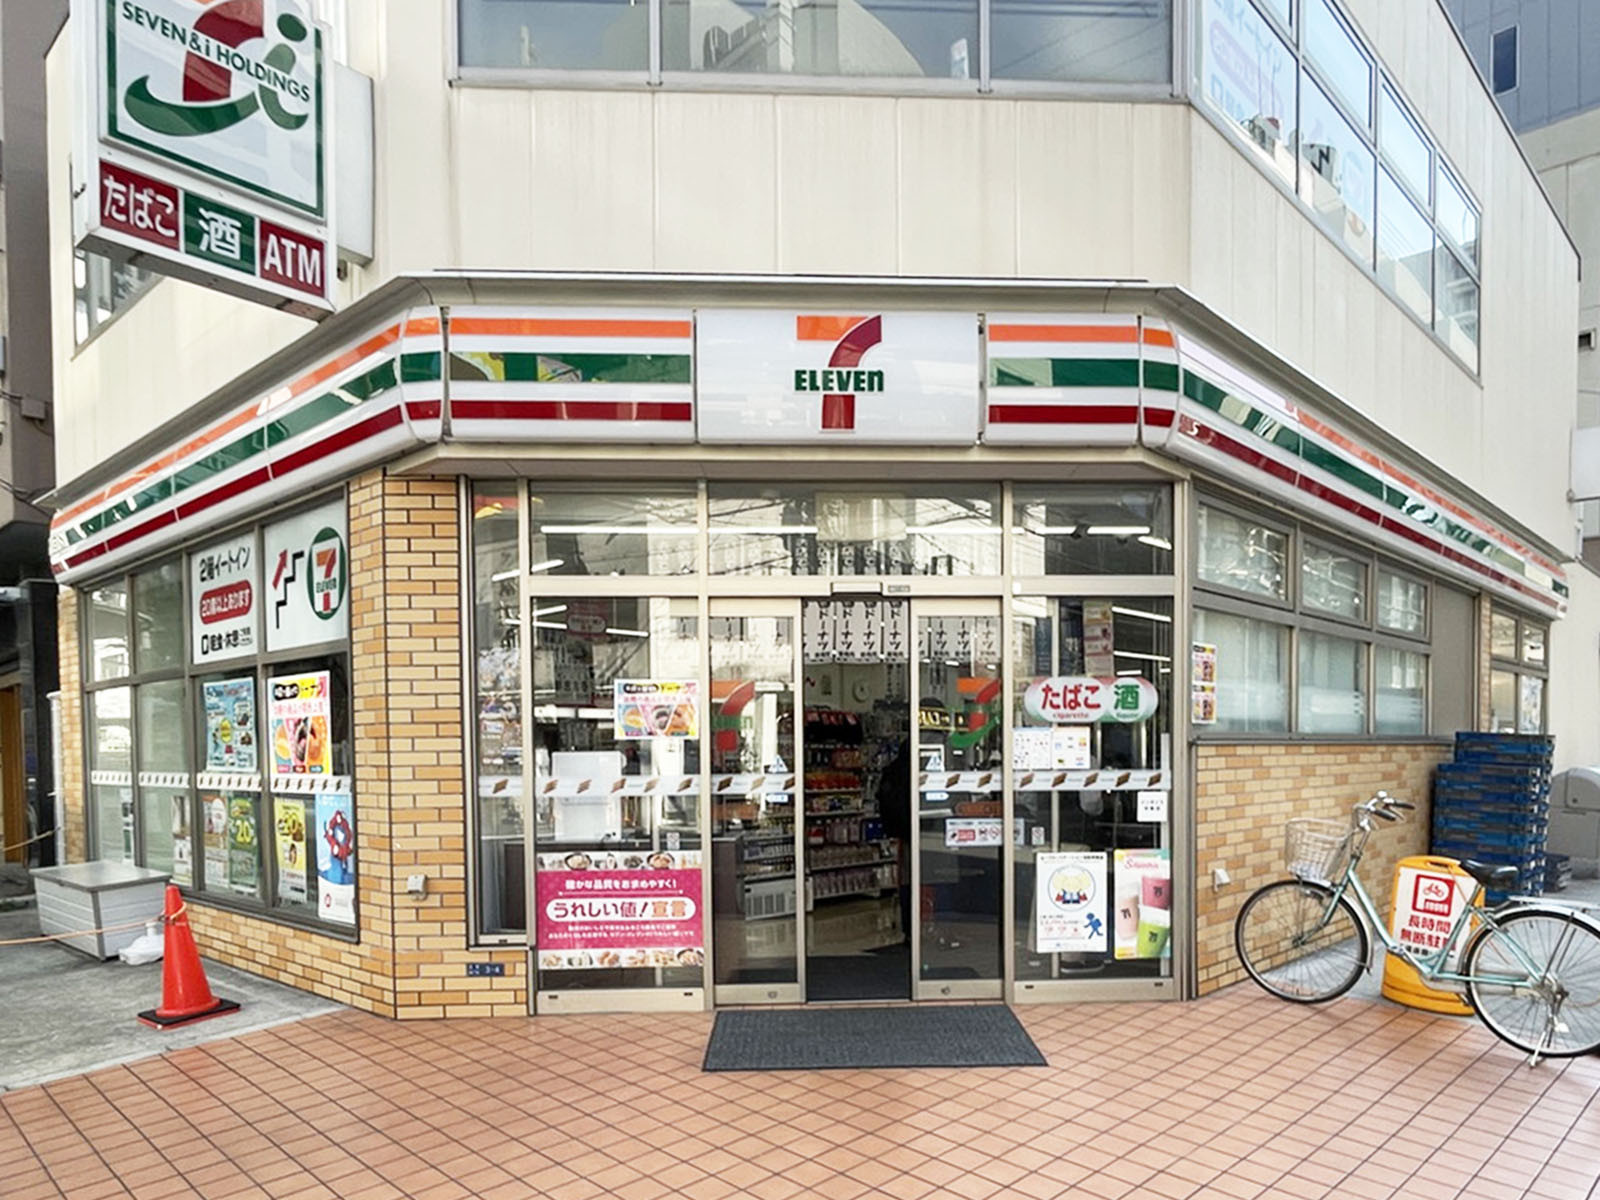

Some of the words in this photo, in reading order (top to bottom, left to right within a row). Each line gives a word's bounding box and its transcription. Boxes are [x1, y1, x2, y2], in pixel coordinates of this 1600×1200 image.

[216, 43, 311, 103] HOLDINGS
[103, 175, 177, 238] たばこ
[198, 207, 242, 261] 酒
[263, 234, 322, 287] ATM
[1041, 683, 1101, 711] たばこ
[1114, 684, 1141, 711] 酒
[553, 900, 687, 919] うれしい値!宣言
[1408, 914, 1452, 935] 長時間
